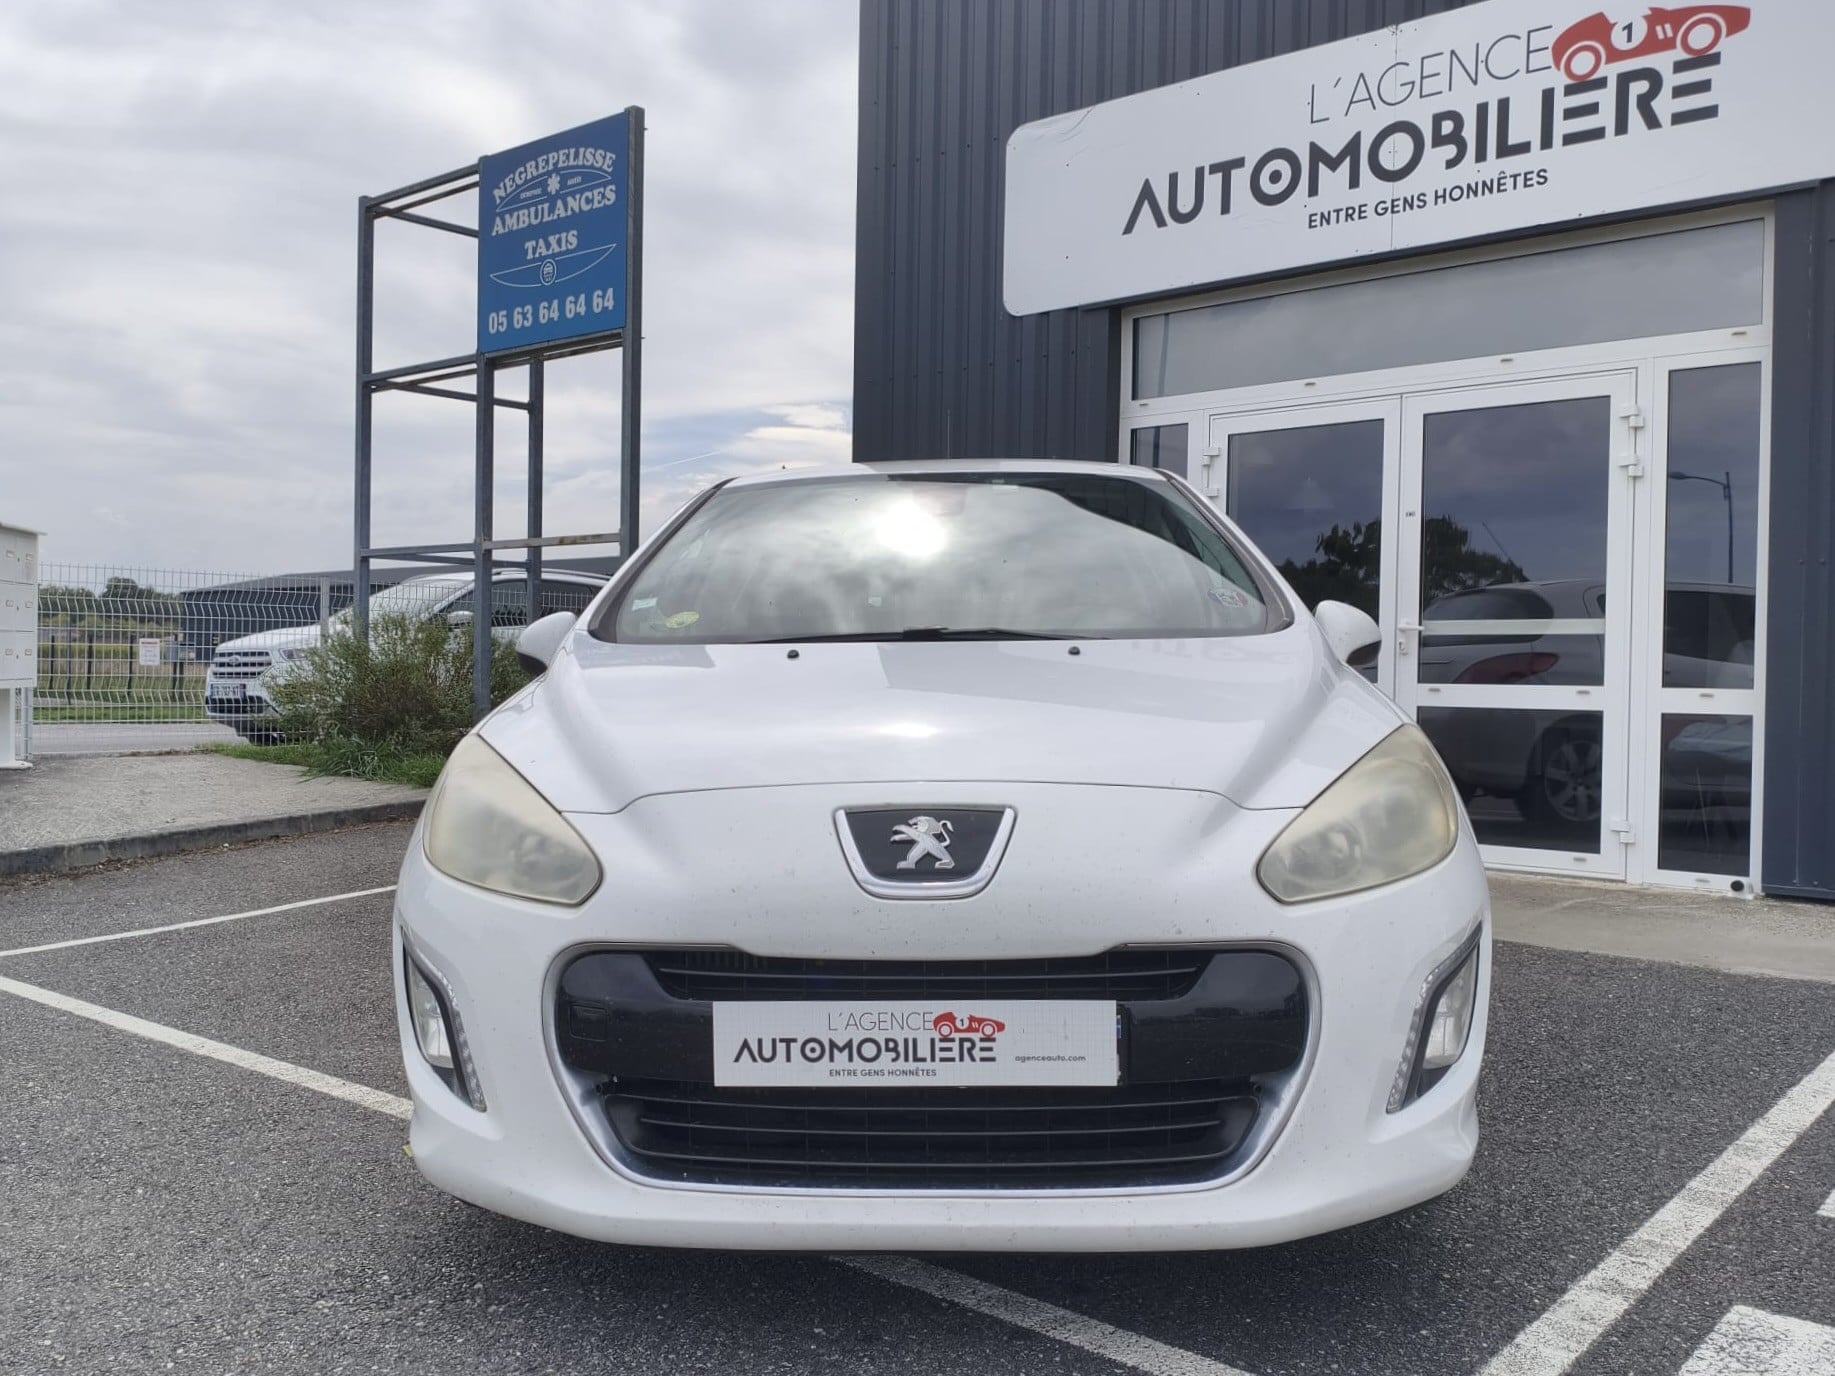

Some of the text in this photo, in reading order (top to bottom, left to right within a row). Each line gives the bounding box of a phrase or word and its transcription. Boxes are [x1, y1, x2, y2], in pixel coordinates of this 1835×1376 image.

[1309, 24, 1554, 124] L'AGENCE
[492, 147, 616, 205] NEGREPELISSE
[1308, 168, 1549, 229] ENTRE GENS HONNÊTES
[491, 184, 617, 236] AMBULANCES
[524, 230, 579, 260] TAXIS
[488, 287, 615, 334] 05 63 64 64 64
[828, 1011, 934, 1032] L'AGENCE
[829, 1066, 937, 1078] ENTRE GENS HONNÊTES
[1014, 1054, 1087, 1064] agenceauto.com
